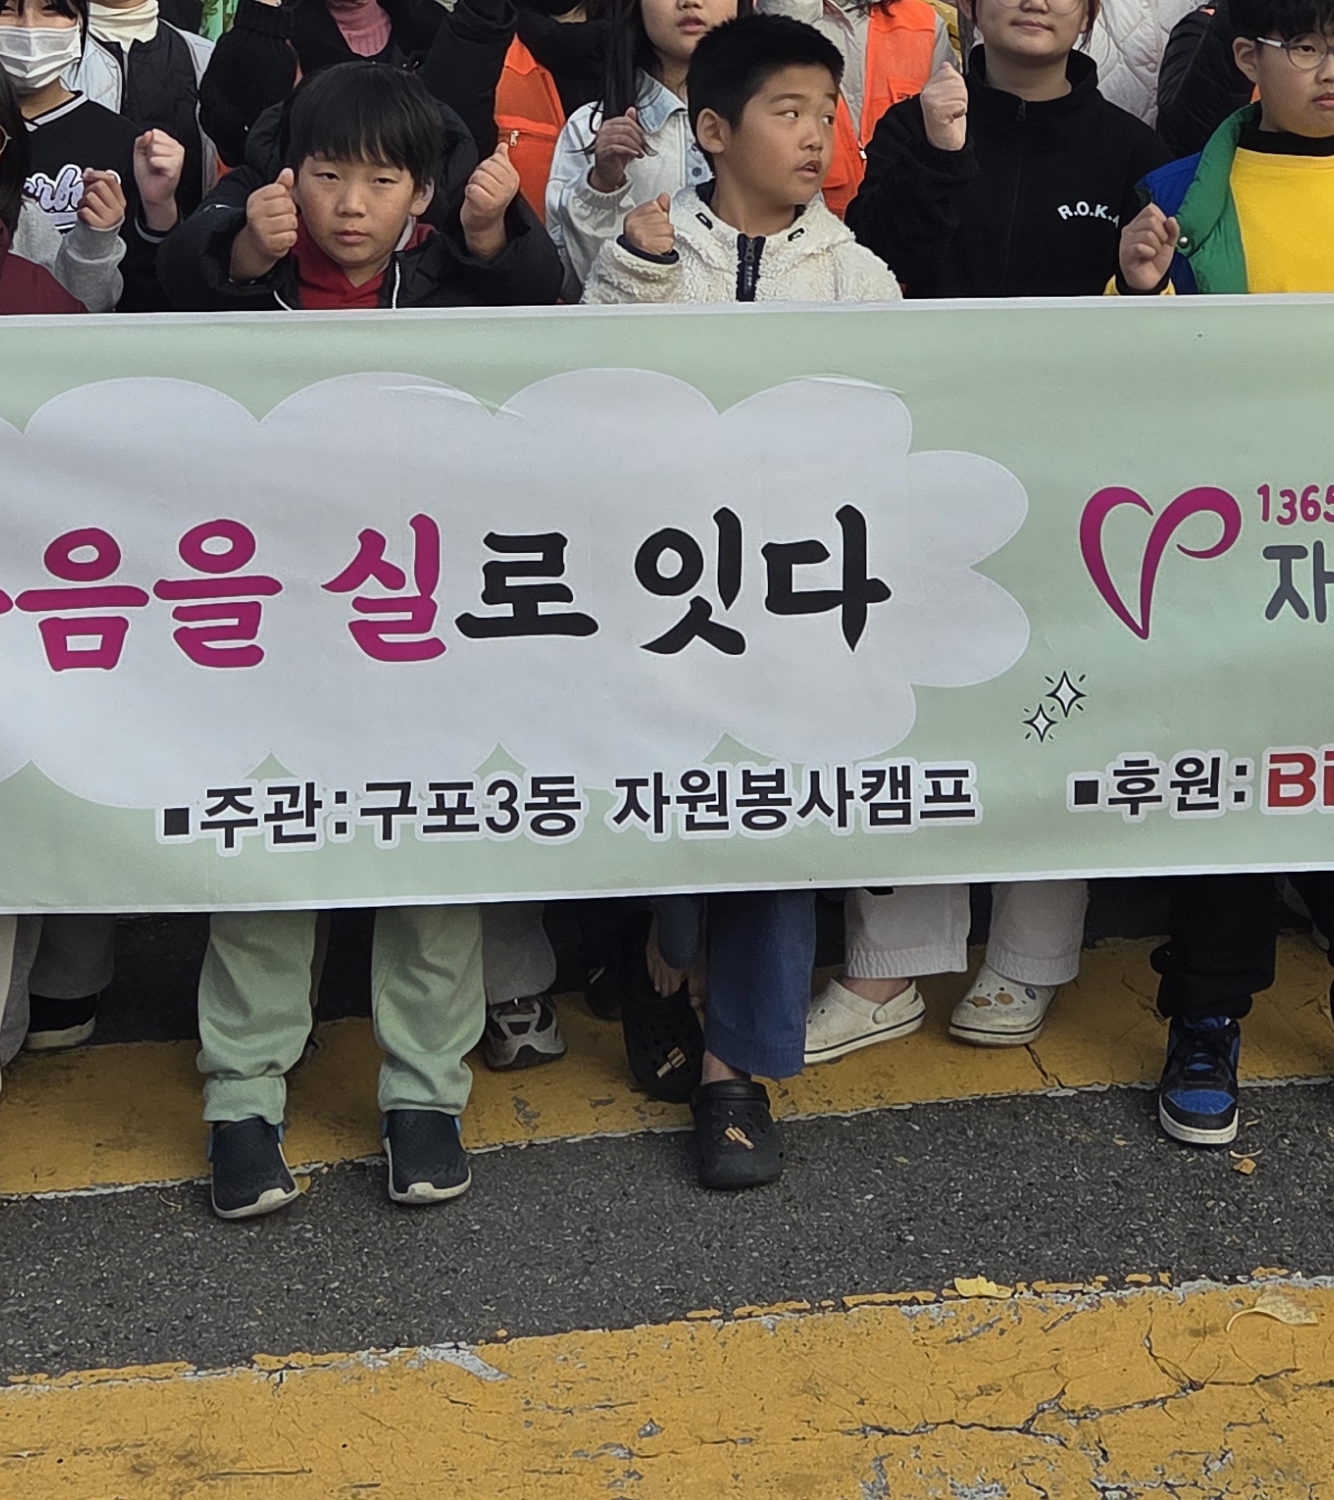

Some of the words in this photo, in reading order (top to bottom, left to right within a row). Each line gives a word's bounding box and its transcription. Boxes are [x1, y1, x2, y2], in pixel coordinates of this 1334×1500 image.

[320, 513, 599, 663] 실로
[634, 503, 893, 655] 잇다
[200, 774, 581, 848] 주관:구포3동
[612, 762, 977, 835] 자원봉사캠프
